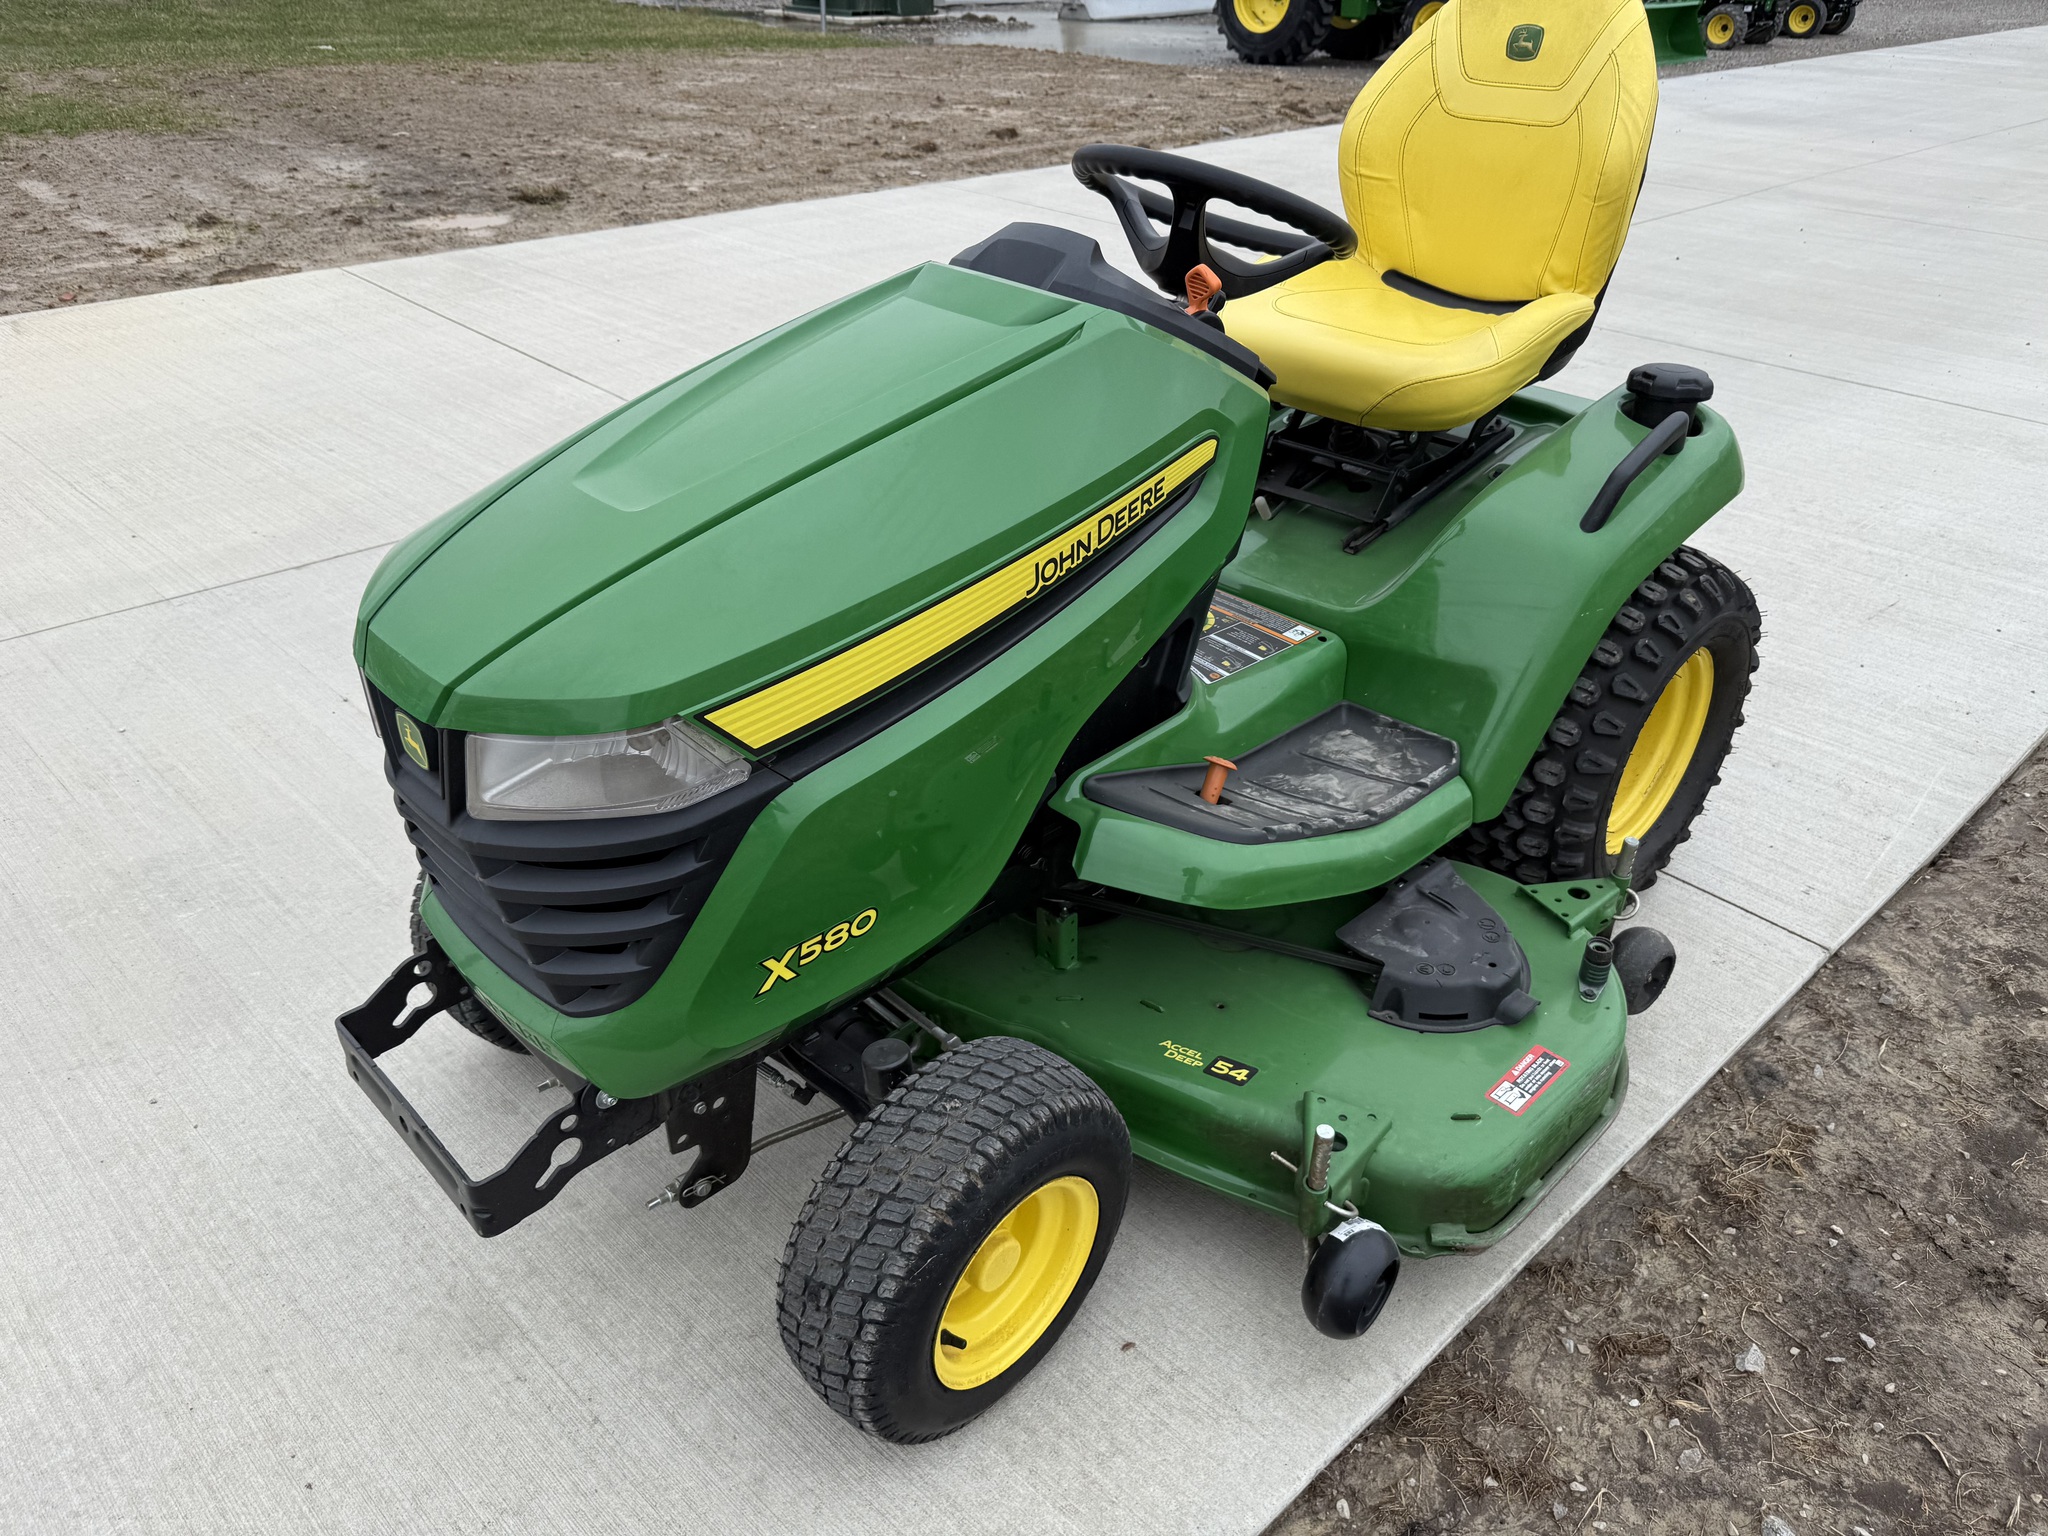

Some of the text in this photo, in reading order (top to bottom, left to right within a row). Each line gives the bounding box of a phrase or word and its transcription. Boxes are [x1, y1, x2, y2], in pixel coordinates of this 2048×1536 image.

[1026, 476, 1166, 597] JOHN DEERE
[753, 907, 878, 998] X580
[1159, 1040, 1203, 1060] ACCEL
[1164, 1050, 1204, 1067] DEEP
[1211, 1060, 1250, 1081] 54
[1516, 1053, 1535, 1072] DANGER
